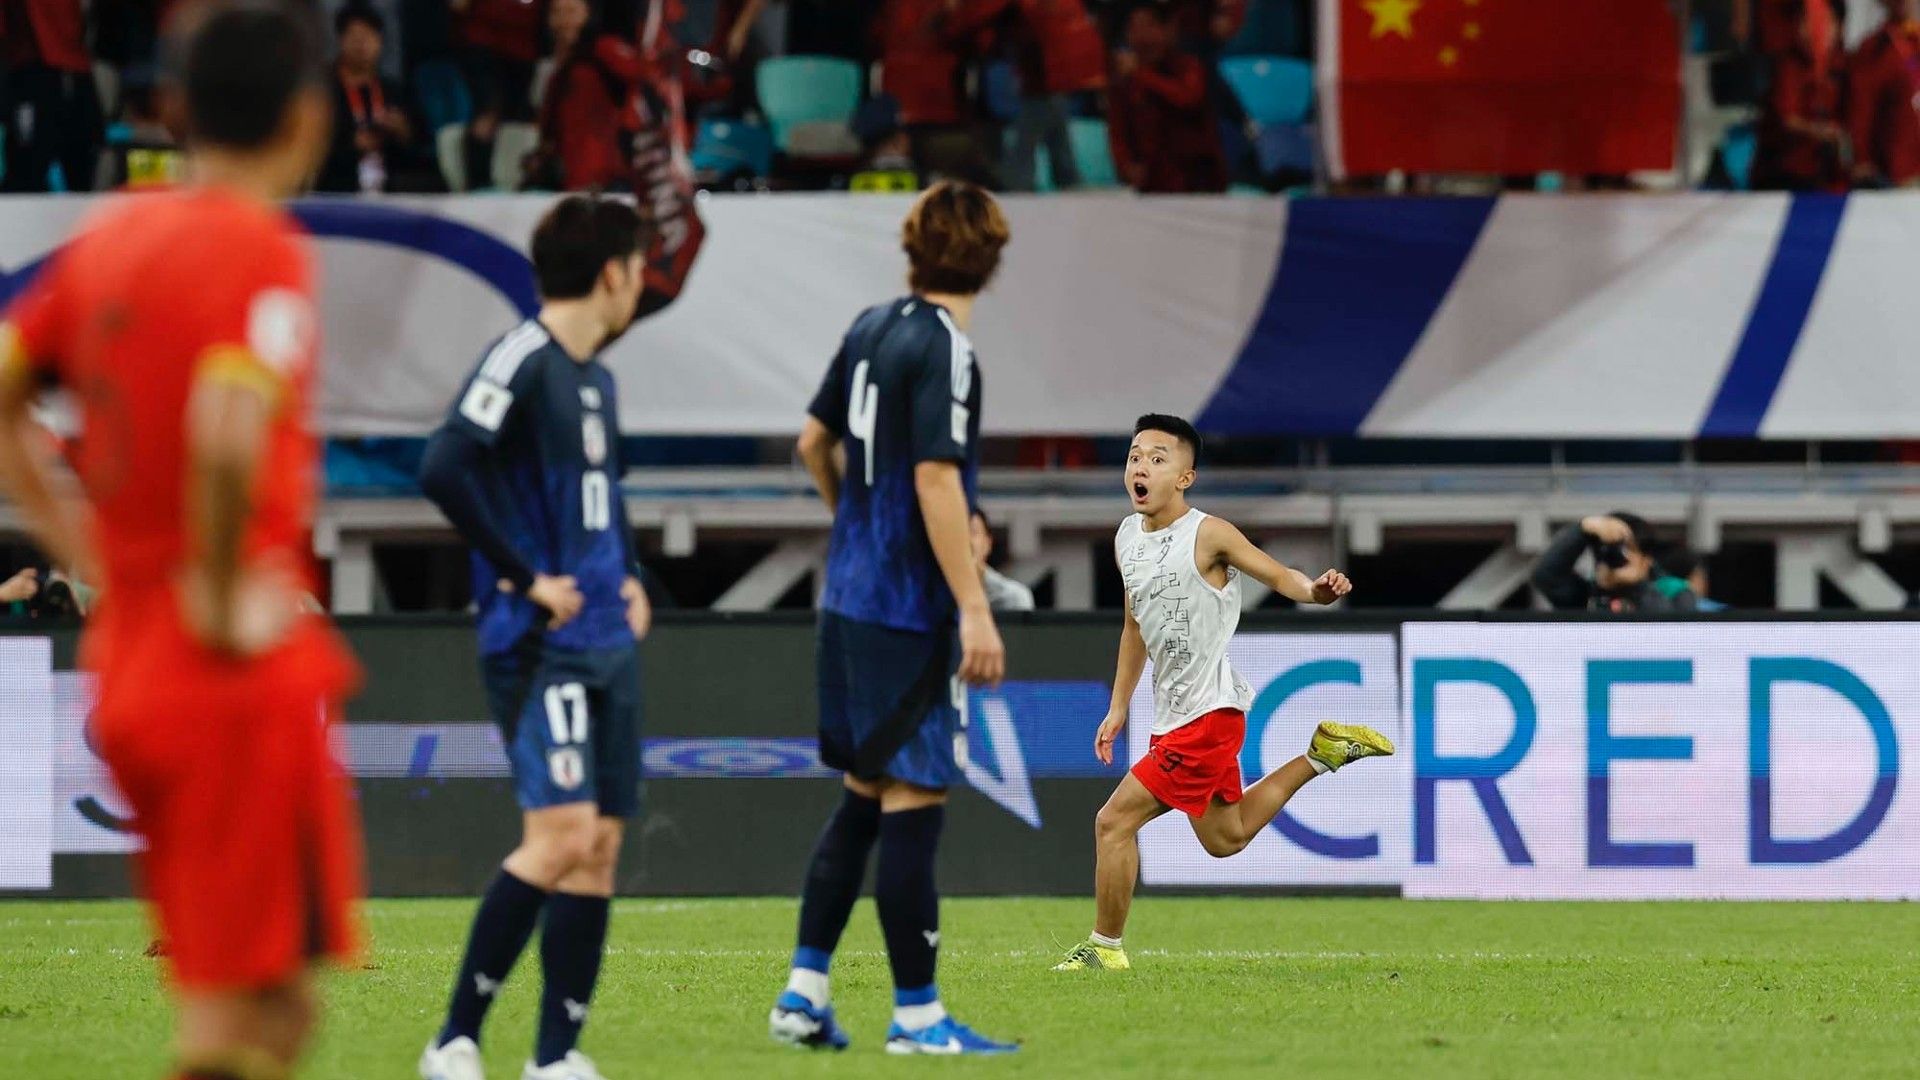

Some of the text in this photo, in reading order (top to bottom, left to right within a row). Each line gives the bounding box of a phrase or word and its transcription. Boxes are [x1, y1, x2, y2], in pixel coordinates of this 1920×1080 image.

[848, 359, 879, 487] 4
[543, 682, 588, 744] 17
[1240, 656, 1899, 868] CRED
